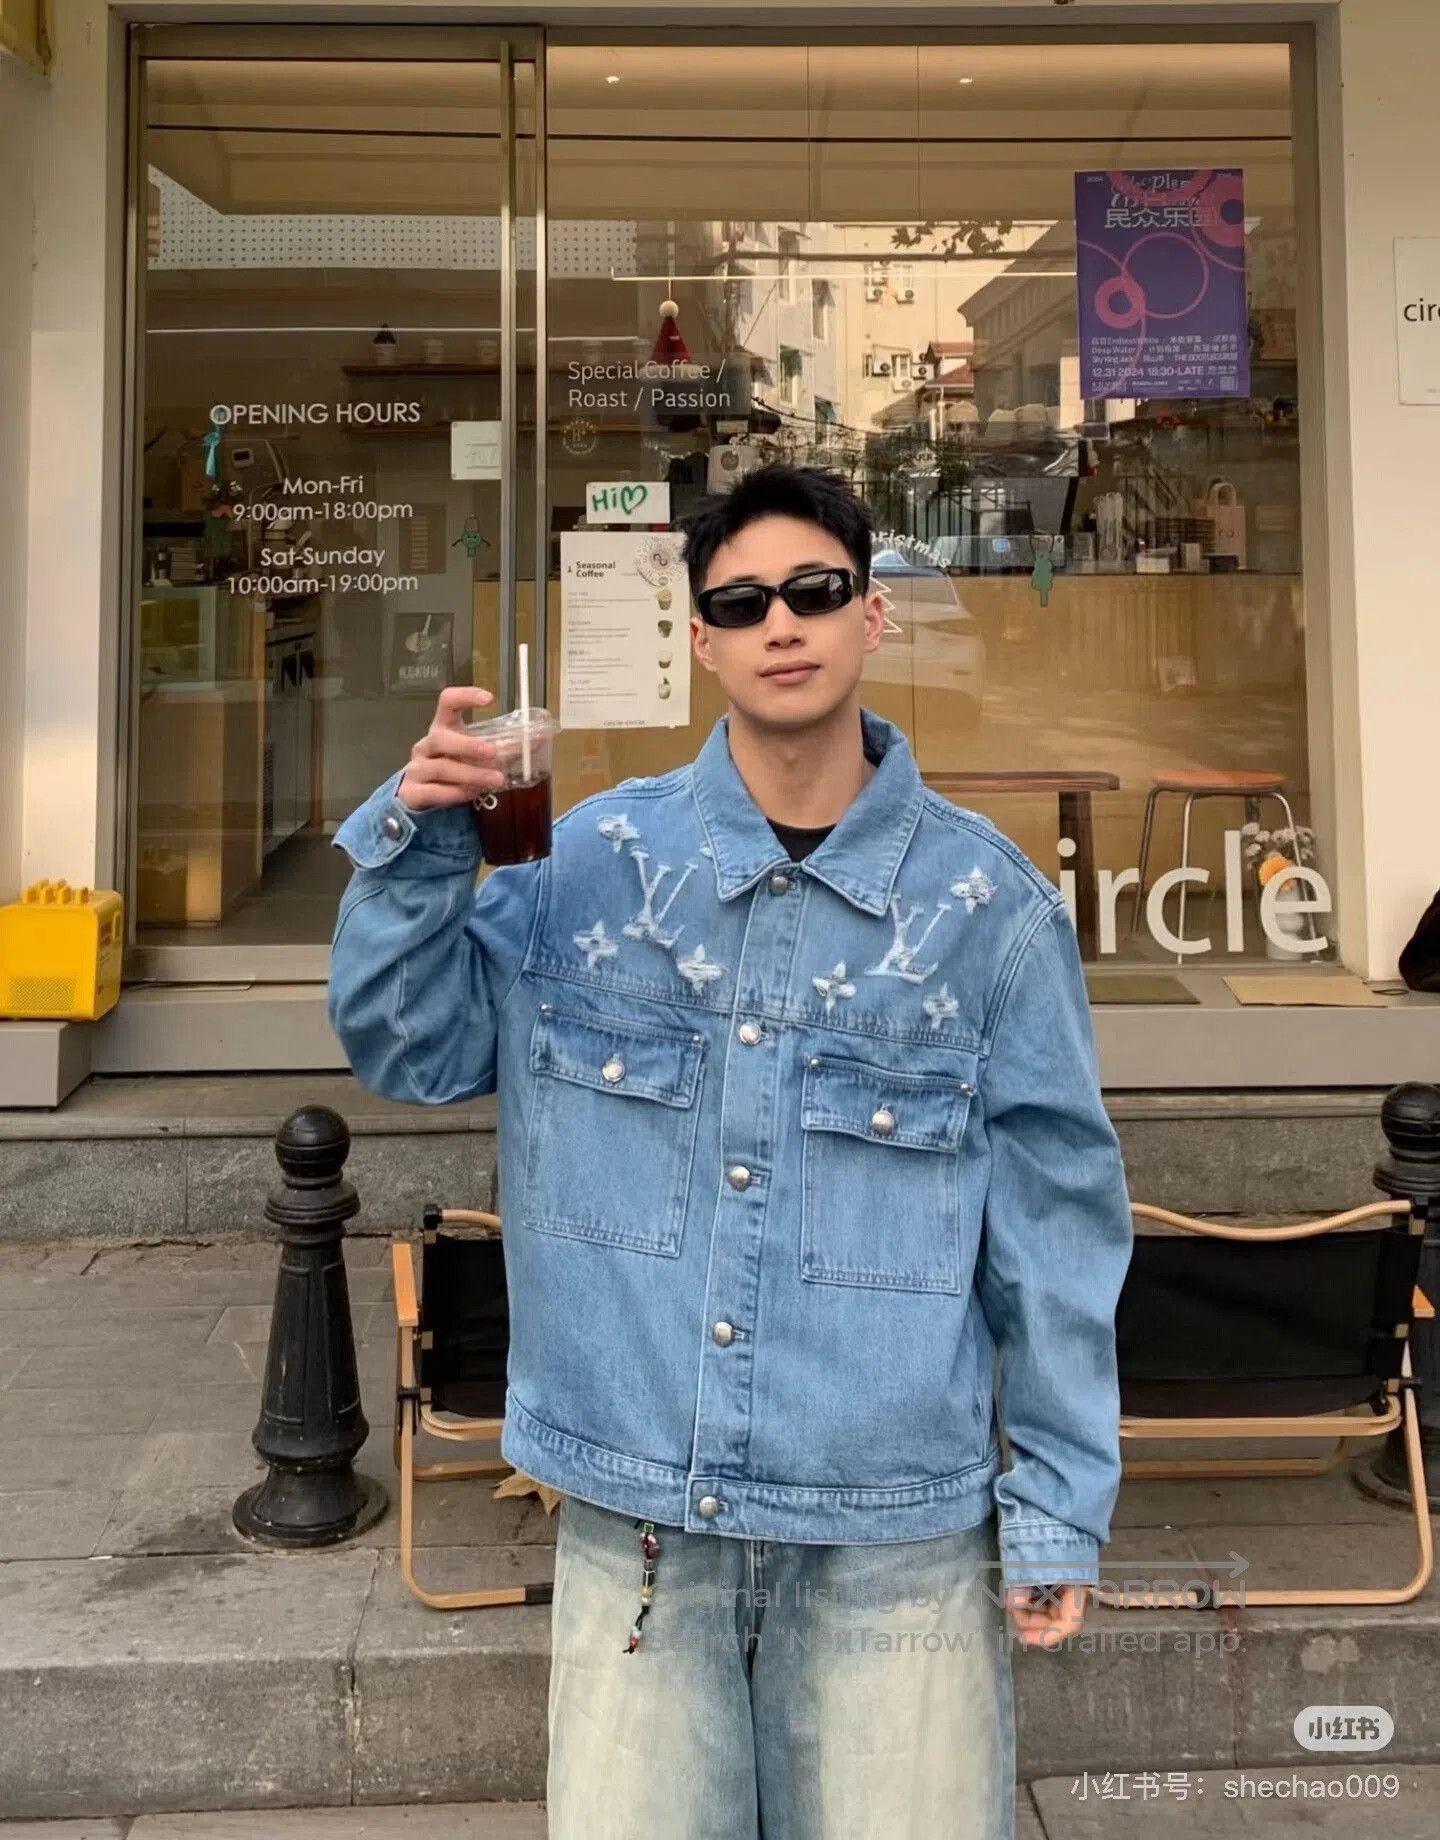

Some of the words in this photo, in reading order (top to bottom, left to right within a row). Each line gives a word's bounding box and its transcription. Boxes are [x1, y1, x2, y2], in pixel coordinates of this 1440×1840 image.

[1403, 298, 1440, 322] cir
[568, 360, 639, 385] Special
[645, 359, 711, 380] Coffee
[569, 388, 628, 408] Roast
[651, 388, 731, 408] Passion
[210, 403, 329, 425] OPENING
[336, 402, 421, 424] HOURS
[282, 475, 364, 496] Mon-Fri
[233, 501, 414, 522] 9:00am-18:00pm
[260, 546, 385, 567] Sat-Sunday
[575, 560, 616, 570] Seasonal
[227, 573, 419, 595] 10:00am-19:00pm
[575, 569, 604, 578] Coffee
[1057, 830, 1333, 954] ircle
